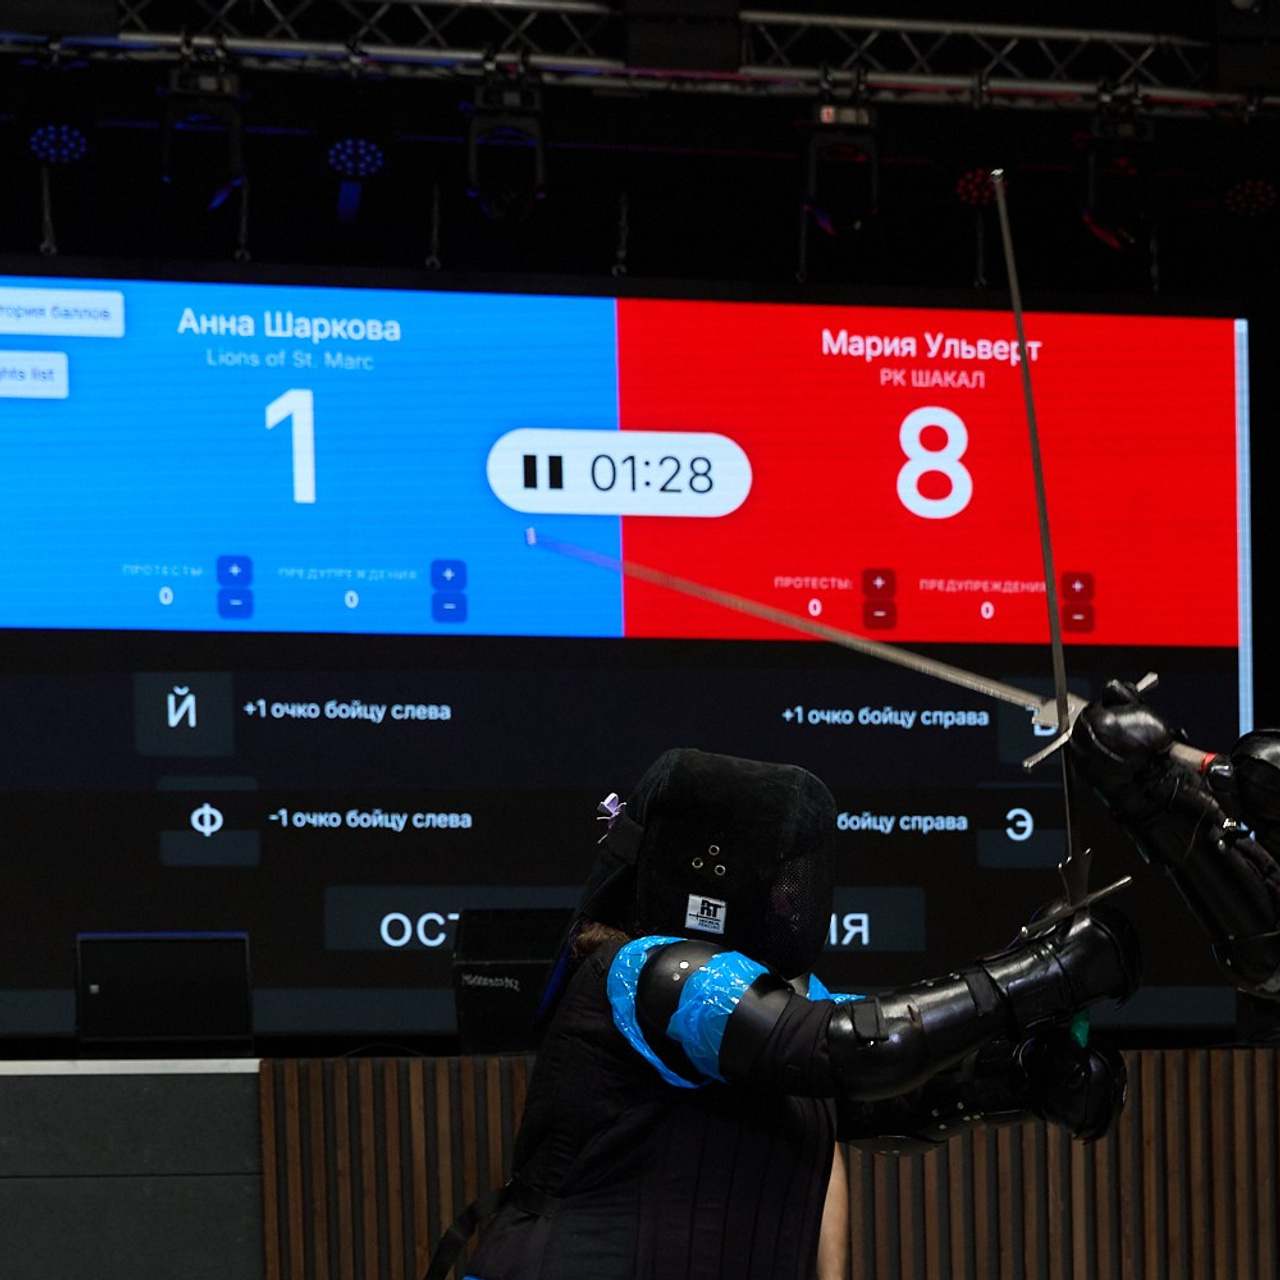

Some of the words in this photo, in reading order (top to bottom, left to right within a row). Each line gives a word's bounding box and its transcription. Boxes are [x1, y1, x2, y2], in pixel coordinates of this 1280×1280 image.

[177, 307, 256, 337] Анна
[263, 310, 401, 345] Шаркова
[206, 348, 260, 368] Lions
[264, 349, 287, 368] of
[292, 350, 317, 370] St.
[323, 351, 375, 372] Marc
[821, 328, 917, 363] Мария
[923, 331, 1043, 367] Ульверт
[879, 366, 907, 387] РК
[911, 368, 986, 389] ШАКАЛ
[264, 388, 317, 505] 1
[590, 453, 714, 495] 01:28
[896, 405, 974, 520] 8
[158, 586, 175, 606] 0
[344, 590, 360, 609] 0
[807, 598, 823, 617] 0
[980, 600, 995, 620] 0
[166, 685, 198, 728] Й
[243, 698, 267, 718] +1
[270, 702, 321, 719] очко
[324, 699, 387, 724] бойцу
[390, 703, 451, 721] слева
[782, 705, 804, 724] +1
[807, 708, 854, 725] очко
[857, 706, 917, 730] бойцу
[920, 710, 990, 730] справа
[190, 802, 224, 838] Ф
[268, 807, 288, 828] -1
[291, 811, 342, 829] очко
[345, 808, 408, 832] бойцу
[411, 812, 473, 829] слева
[836, 811, 896, 835] бойцу
[899, 814, 969, 835] справа
[1005, 808, 1035, 842] Э
